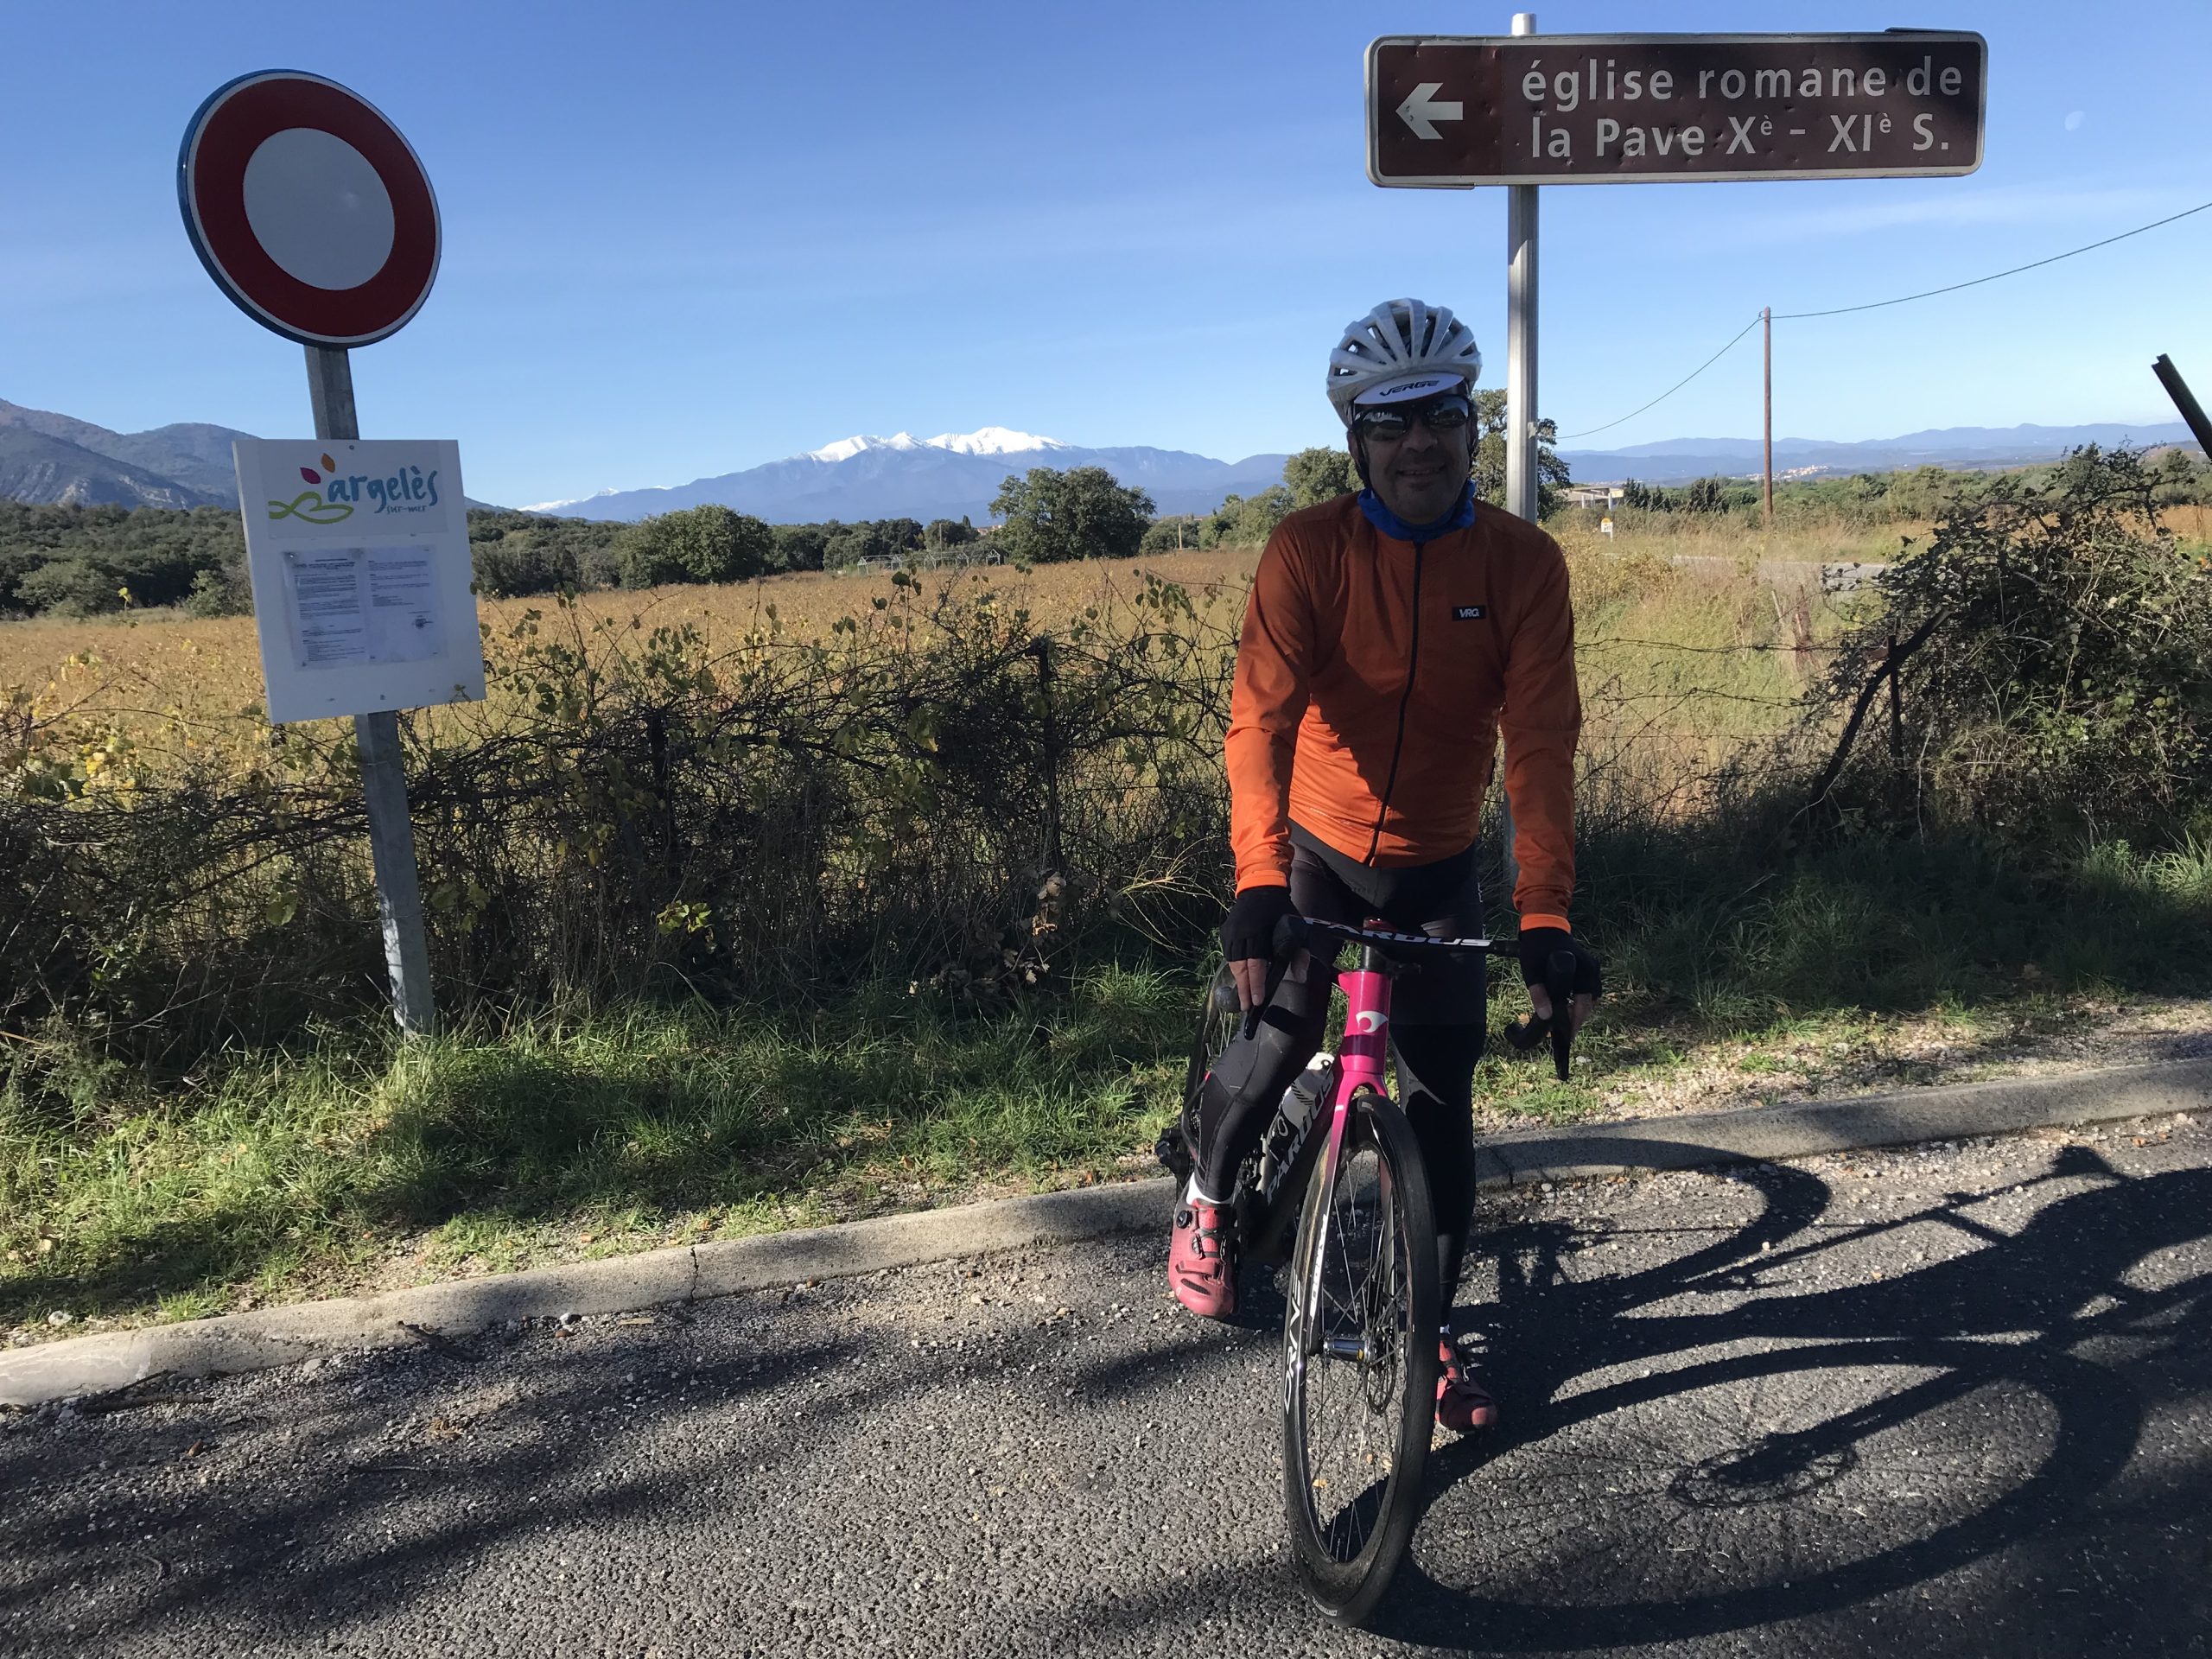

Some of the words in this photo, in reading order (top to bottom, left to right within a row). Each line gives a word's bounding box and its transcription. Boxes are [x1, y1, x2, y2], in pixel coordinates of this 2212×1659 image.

[1522, 59, 1674, 112] église
[1698, 67, 1886, 99] romane
[1906, 55, 1962, 96] de
[1531, 116, 1571, 158] la
[1596, 118, 1706, 158] Pave
[1912, 112, 1949, 151] S.
[327, 465, 438, 514] argelès
[386, 505, 428, 515] sur-mer
[1459, 607, 1480, 618] VRG
[1304, 917, 1494, 947] PARDUS
